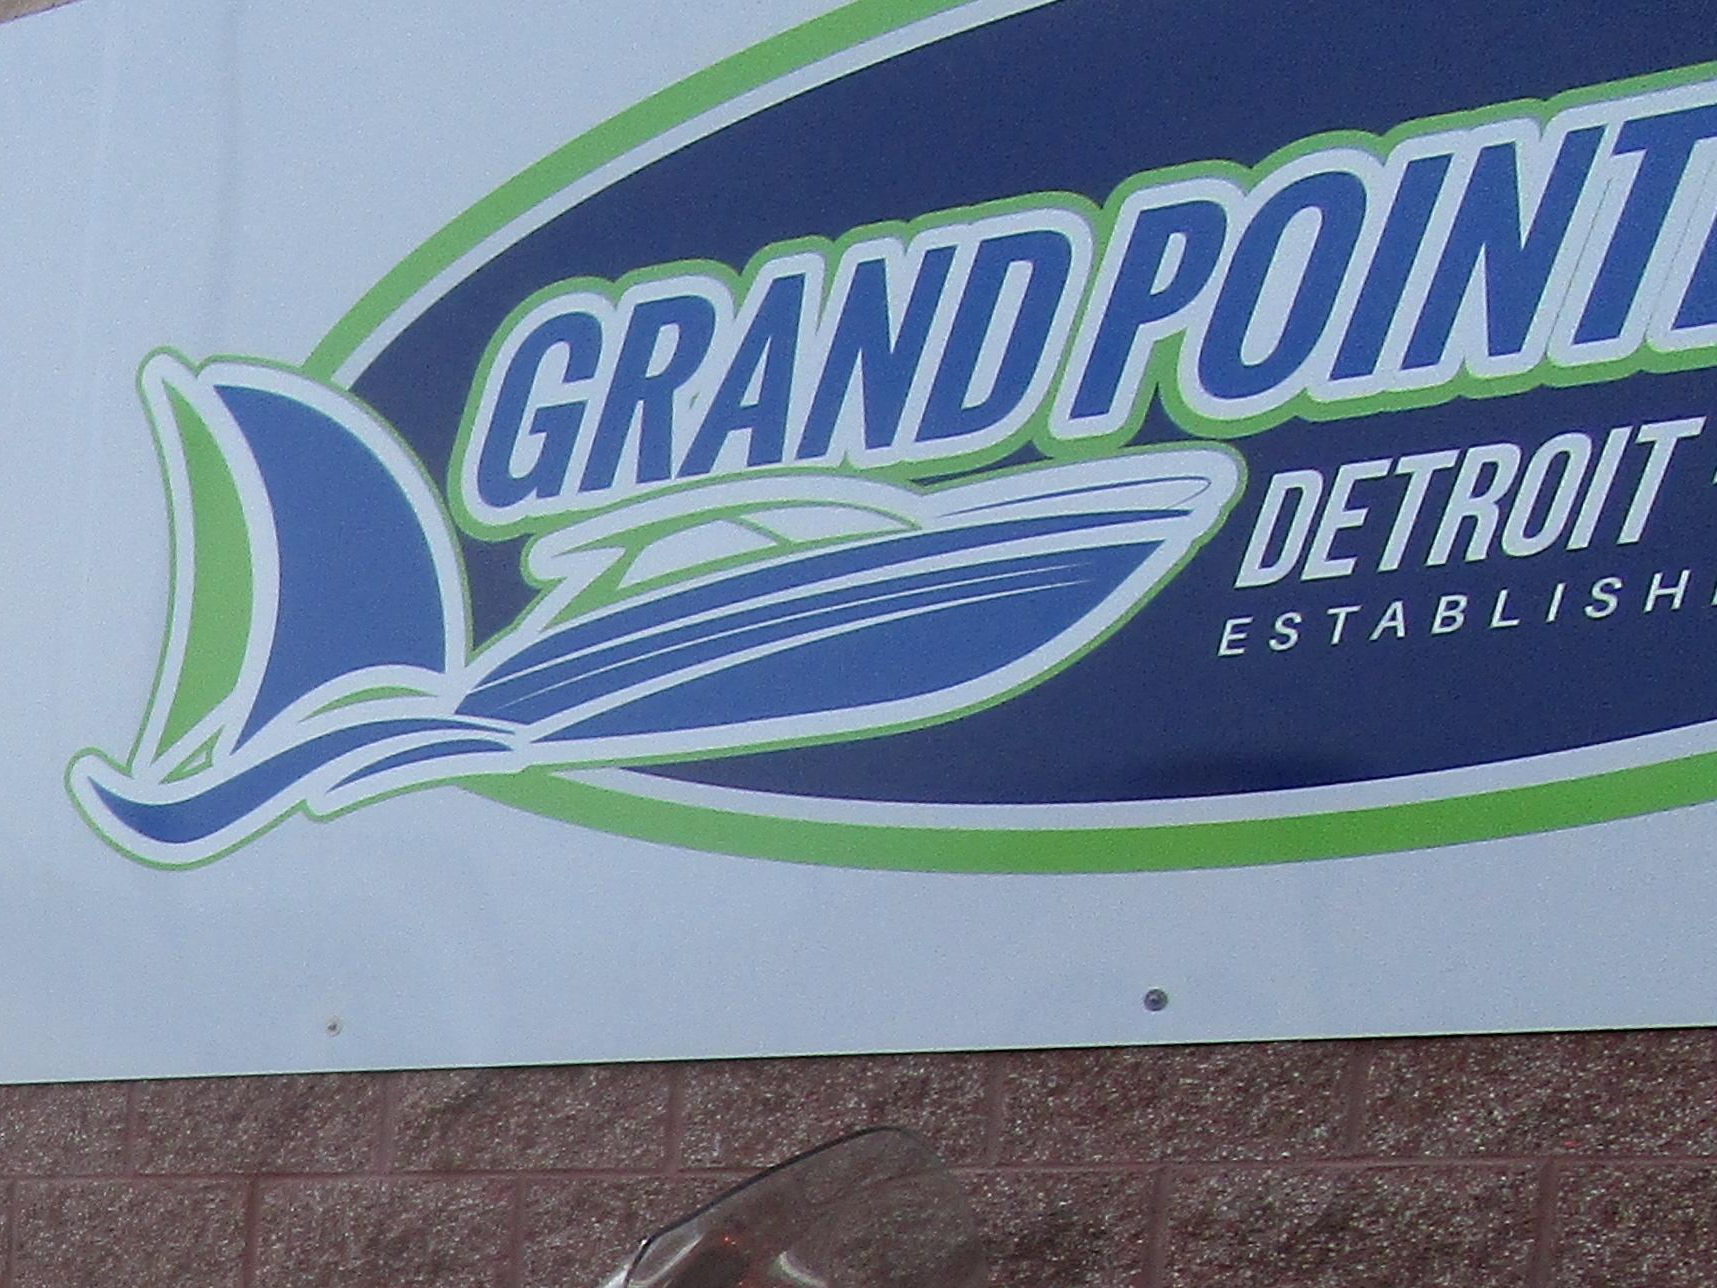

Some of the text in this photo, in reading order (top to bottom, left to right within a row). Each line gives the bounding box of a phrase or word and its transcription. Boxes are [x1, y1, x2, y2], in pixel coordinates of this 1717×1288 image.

[476, 228, 1073, 511] GRAND
[1233, 416, 1706, 589] DETROIT
[1217, 570, 1717, 657] ESTABLISH
